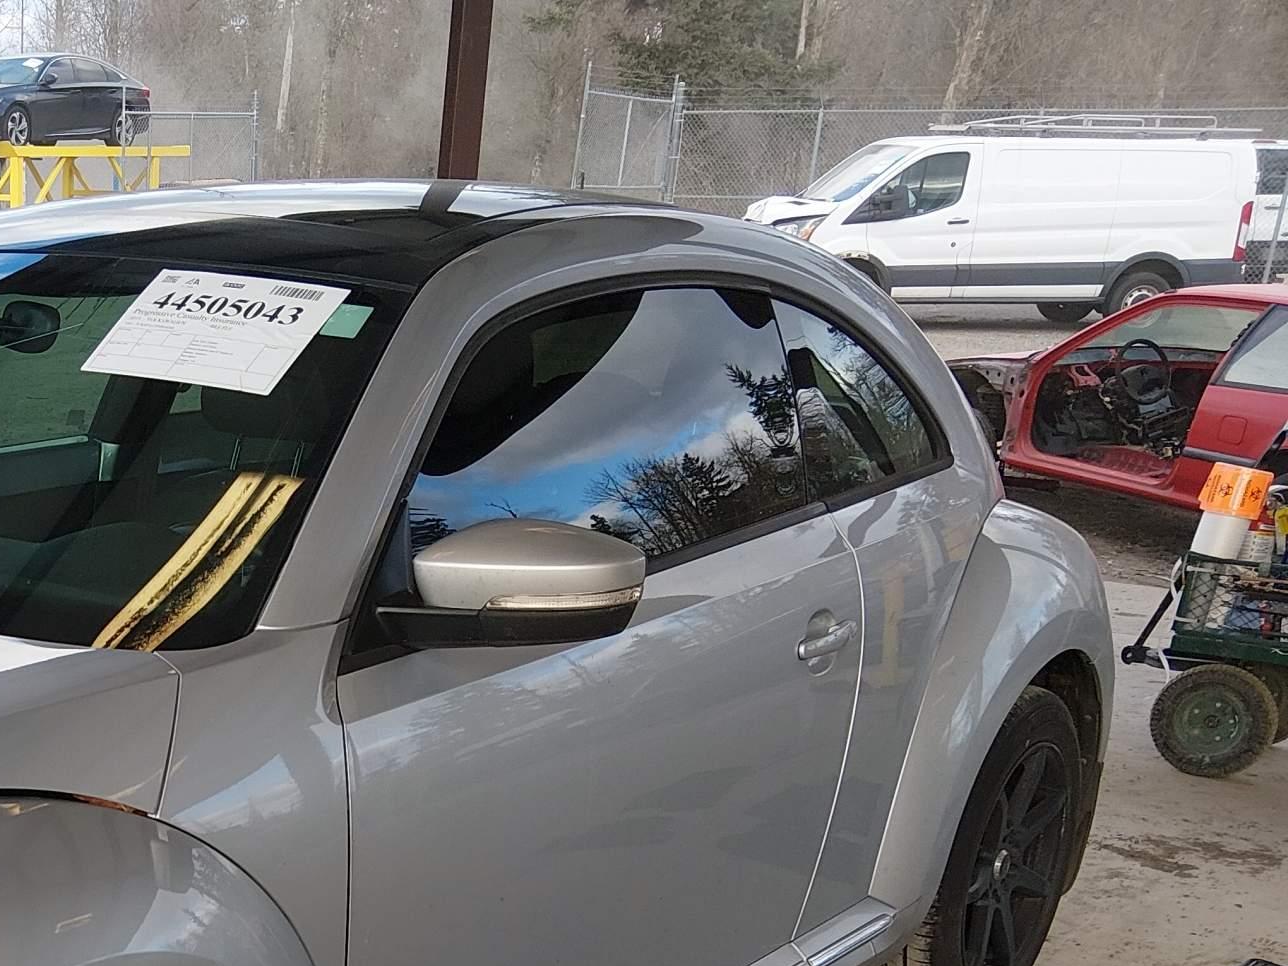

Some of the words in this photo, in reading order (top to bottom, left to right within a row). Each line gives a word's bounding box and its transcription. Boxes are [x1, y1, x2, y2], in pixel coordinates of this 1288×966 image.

[133, 308, 177, 318] Progressive
[177, 312, 209, 321] Casualty
[211, 316, 248, 327] Insurance
[153, 291, 304, 326] 44505043
